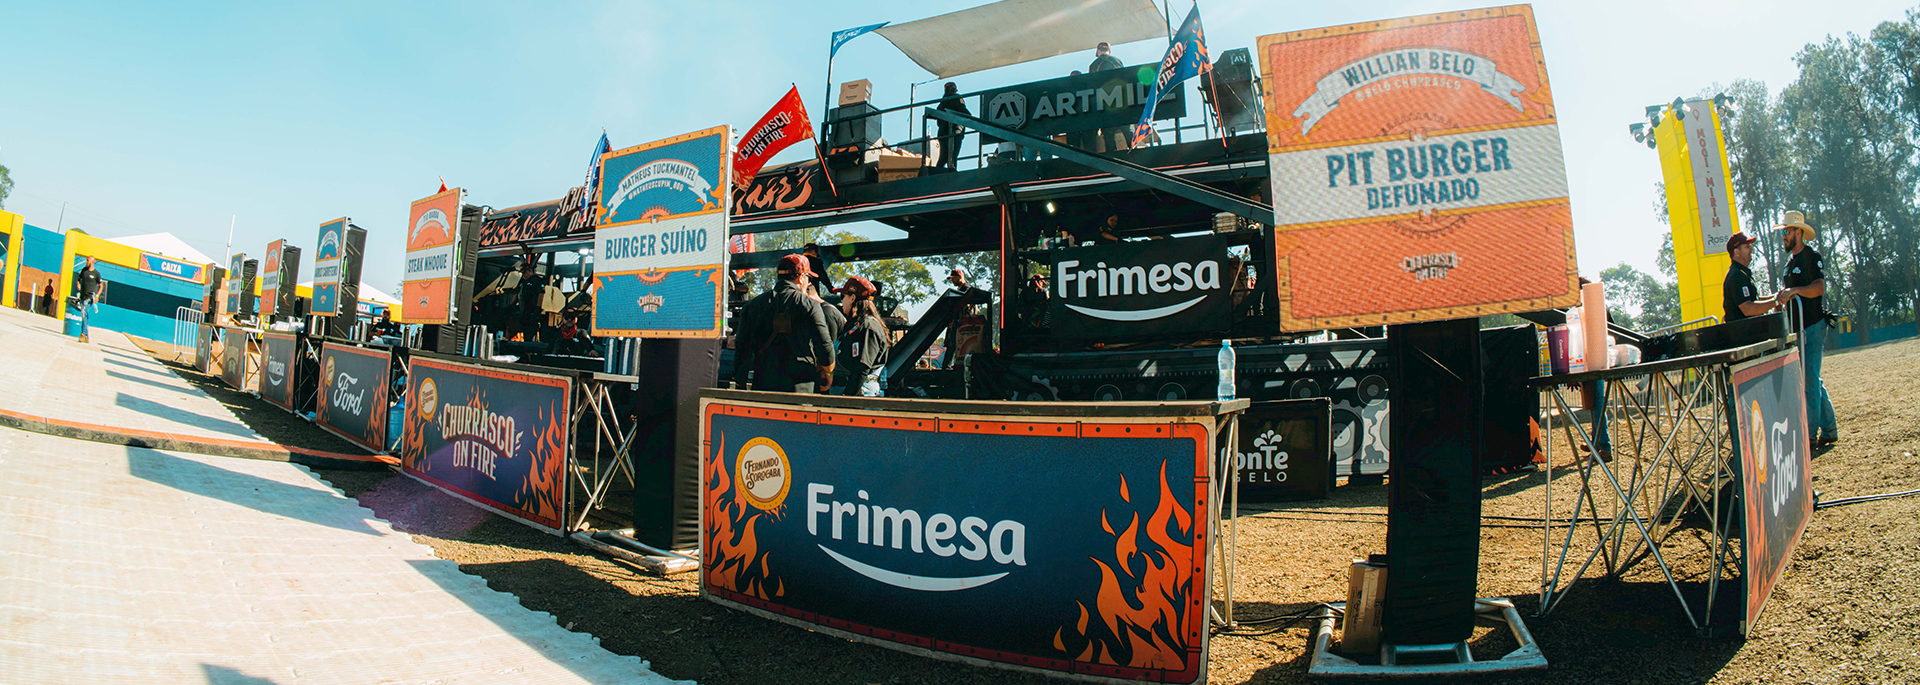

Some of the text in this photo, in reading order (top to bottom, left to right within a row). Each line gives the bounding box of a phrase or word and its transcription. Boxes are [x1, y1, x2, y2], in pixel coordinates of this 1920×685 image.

[1340, 51, 1476, 87] WILLIAN BELO
[1355, 76, 1461, 102] @BELO.CHURRASCO
[739, 111, 791, 160] CHURRASCO
[754, 128, 787, 157] ON FIRE
[621, 163, 696, 192] MATHEUS TUCKMANTEL
[1326, 137, 1513, 188] PIT BURGER
[1366, 177, 1480, 210] DEFUMADO
[605, 234, 657, 260] BURGER
[660, 225, 707, 255] SUÍNO
[161, 261, 182, 275] CAIXA
[408, 257, 424, 273] STEAK
[1057, 260, 1221, 298] Frimesa
[333, 372, 365, 416] Ford
[442, 403, 515, 459] CHURRASCO
[453, 440, 498, 482] ON FIRE
[744, 457, 779, 474] FERNANDO
[1772, 417, 1798, 517] Ford
[807, 482, 1027, 567] Frimesa
